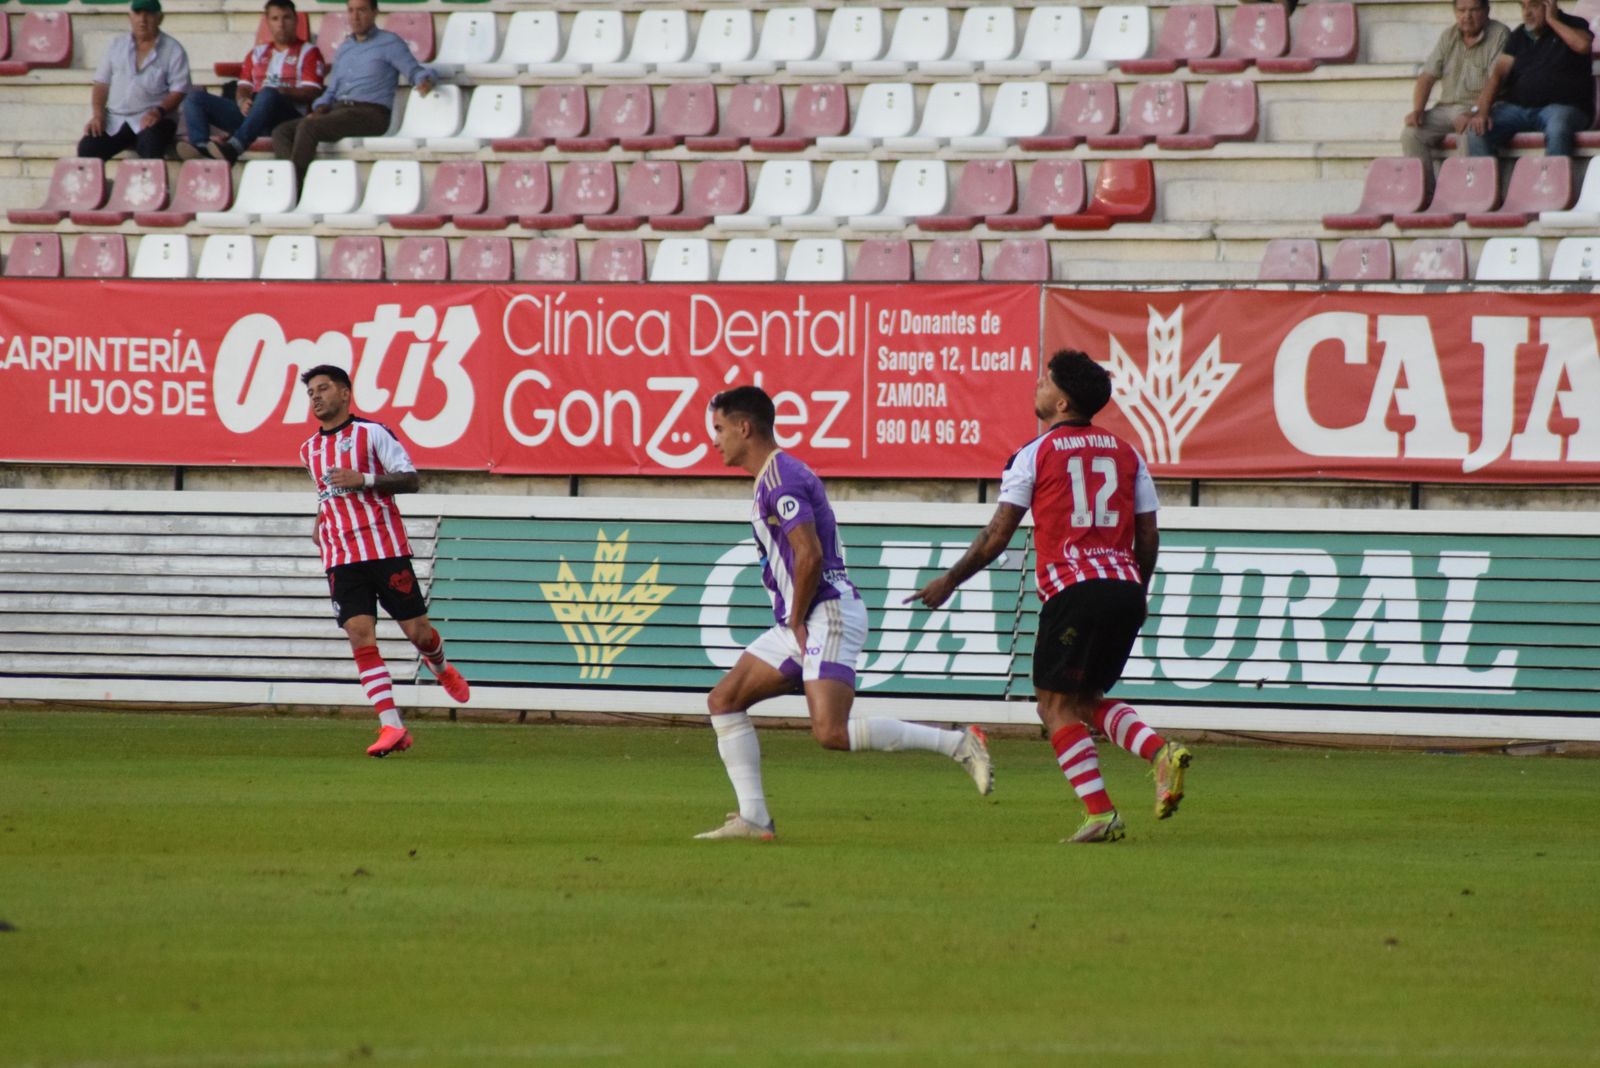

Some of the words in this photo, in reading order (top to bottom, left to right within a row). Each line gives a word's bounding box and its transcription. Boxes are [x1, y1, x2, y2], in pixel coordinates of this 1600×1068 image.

[502, 291, 671, 356] Clínica
[689, 294, 856, 357] Dental
[878, 309, 897, 336] C/
[900, 309, 976, 335] Donantes
[981, 309, 1001, 335] de
[877, 346, 934, 376] Sangre
[940, 346, 965, 374] 12,
[971, 346, 1015, 372] Local
[1020, 346, 1033, 372] A
[49, 379, 154, 415] HIJOS
[162, 380, 206, 416] DE
[876, 382, 948, 408] ZAMORA
[1273, 311, 1600, 473] CAJA
[876, 419, 906, 445] 980
[911, 419, 931, 445] 04
[935, 419, 955, 445] 96
[960, 419, 980, 445] 23
[1052, 435, 1086, 451] MANU
[1085, 434, 1118, 449] VIANA
[1066, 456, 1120, 528] 12
[782, 500, 796, 516] JD
[698, 538, 1014, 688] CJA
[1121, 546, 1518, 694] URAL
